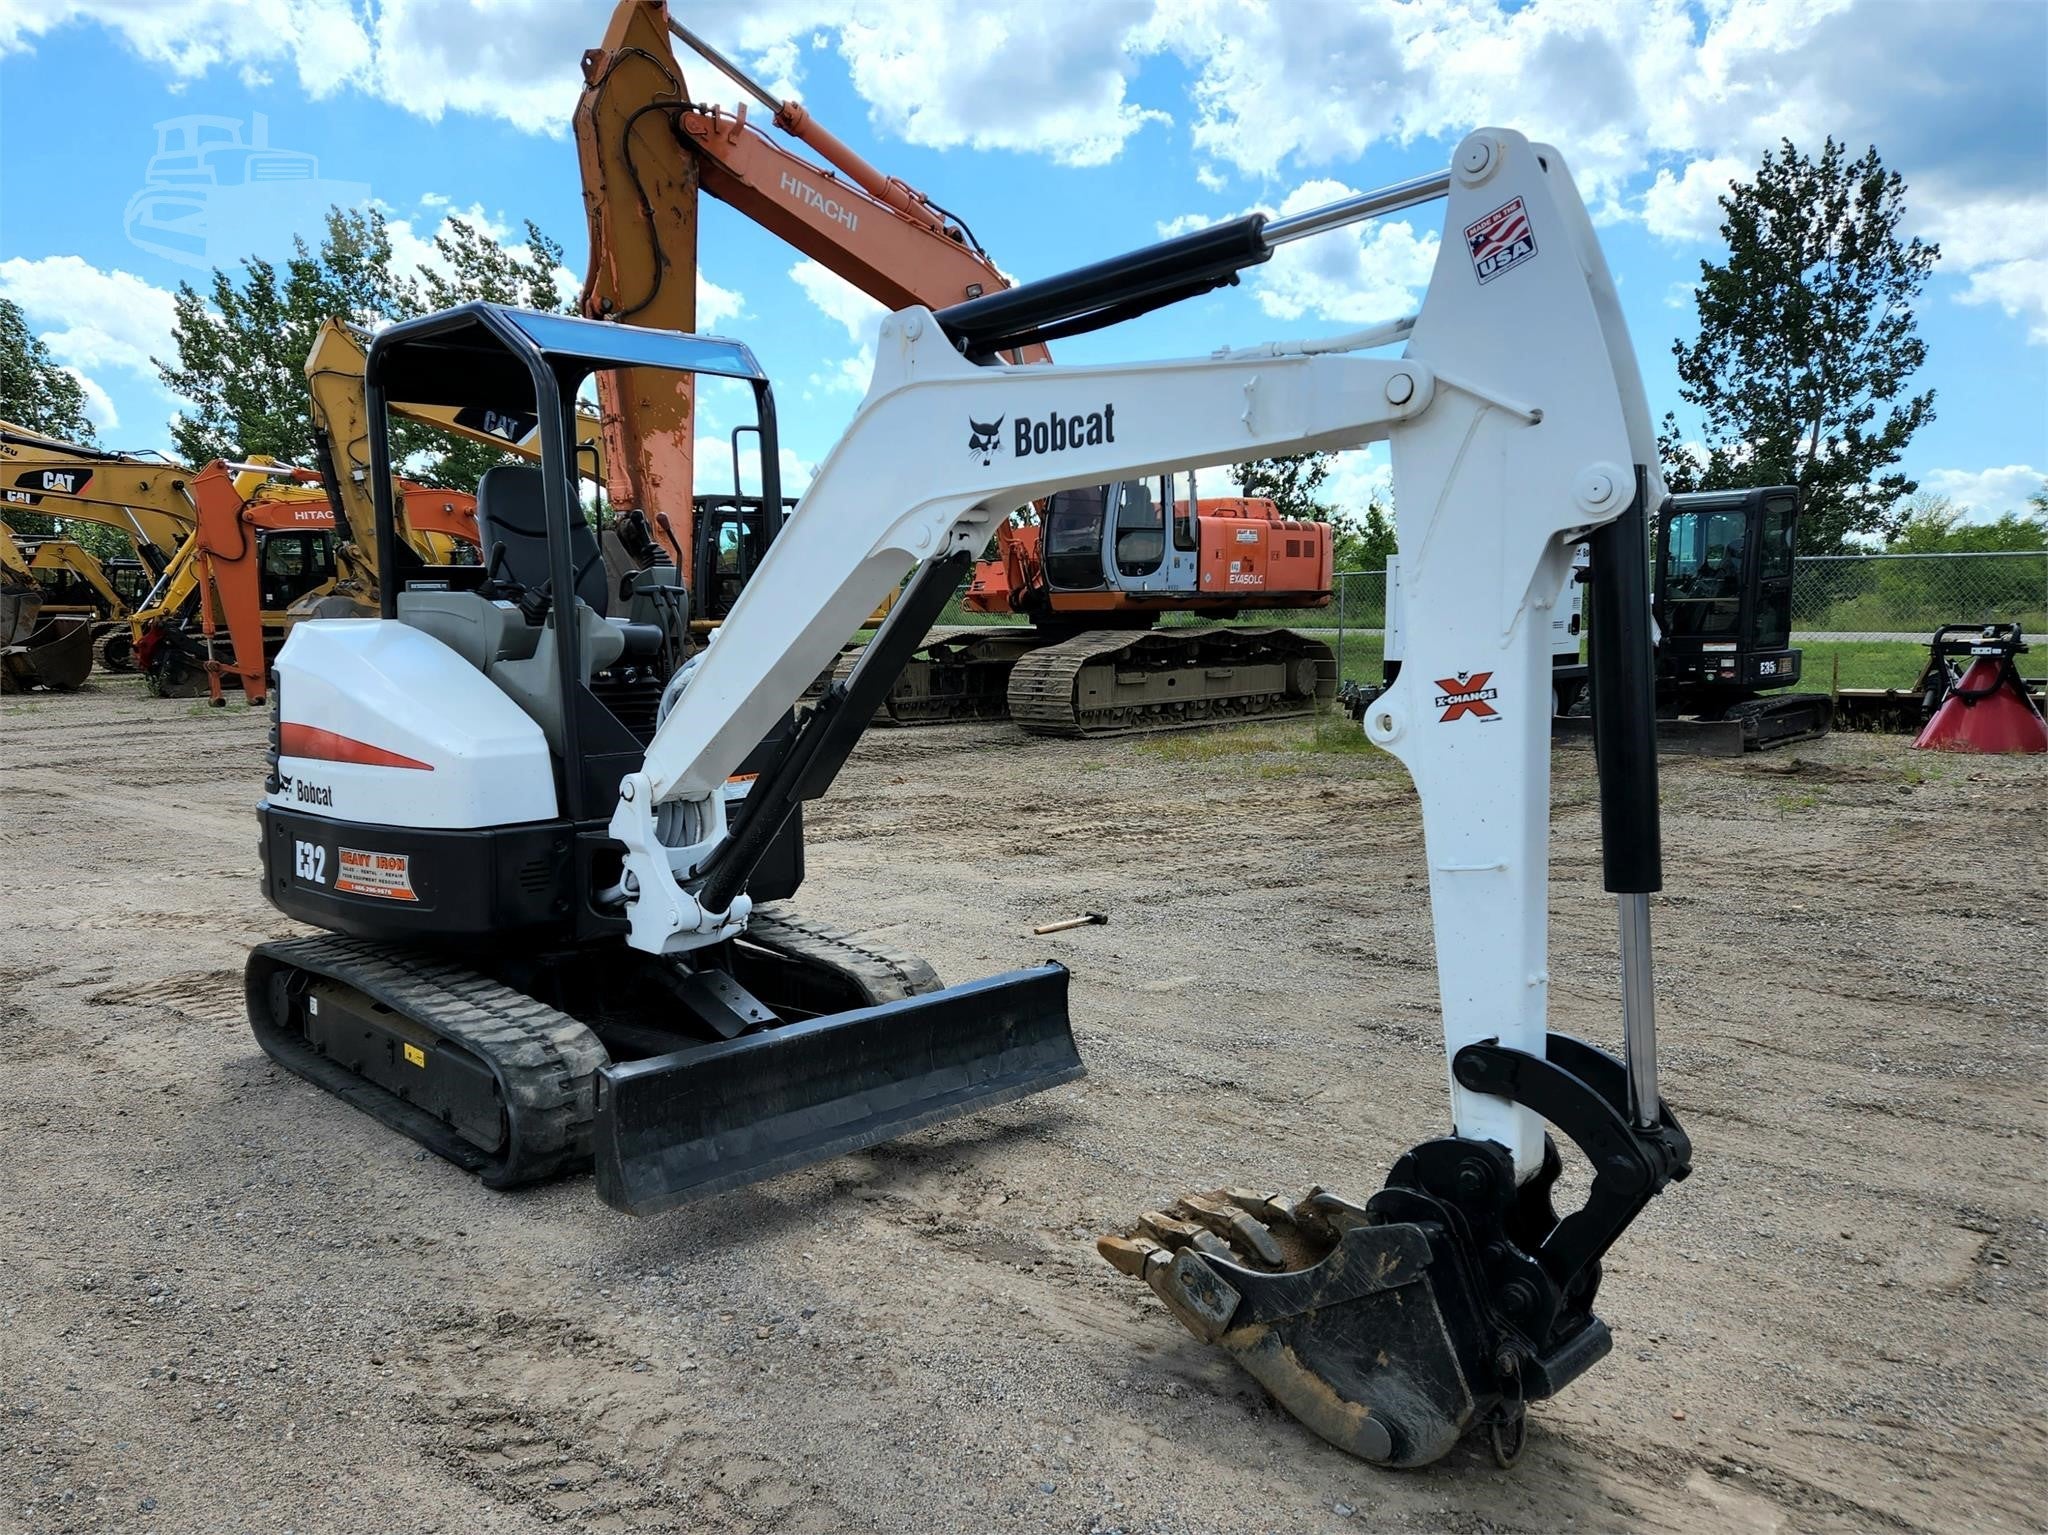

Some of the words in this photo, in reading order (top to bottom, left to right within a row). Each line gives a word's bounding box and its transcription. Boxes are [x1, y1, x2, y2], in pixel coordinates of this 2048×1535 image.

[780, 171, 858, 232] HITACHI
[1469, 219, 1492, 236] MADE
[1492, 214, 1502, 222] IN
[1502, 202, 1519, 216] THE
[1479, 240, 1531, 276] USA
[483, 410, 519, 440] CAT
[1014, 403, 1115, 458] Bobcat
[42, 471, 75, 493] CAT
[294, 510, 335, 520] HITAC
[1229, 574, 1264, 585] EX450LC
[1436, 689, 1496, 706] X-CHANGE
[296, 779, 333, 808] Bobcat
[295, 840, 326, 885] E32
[340, 851, 371, 868] HEAVY
[376, 856, 405, 872] IRON
